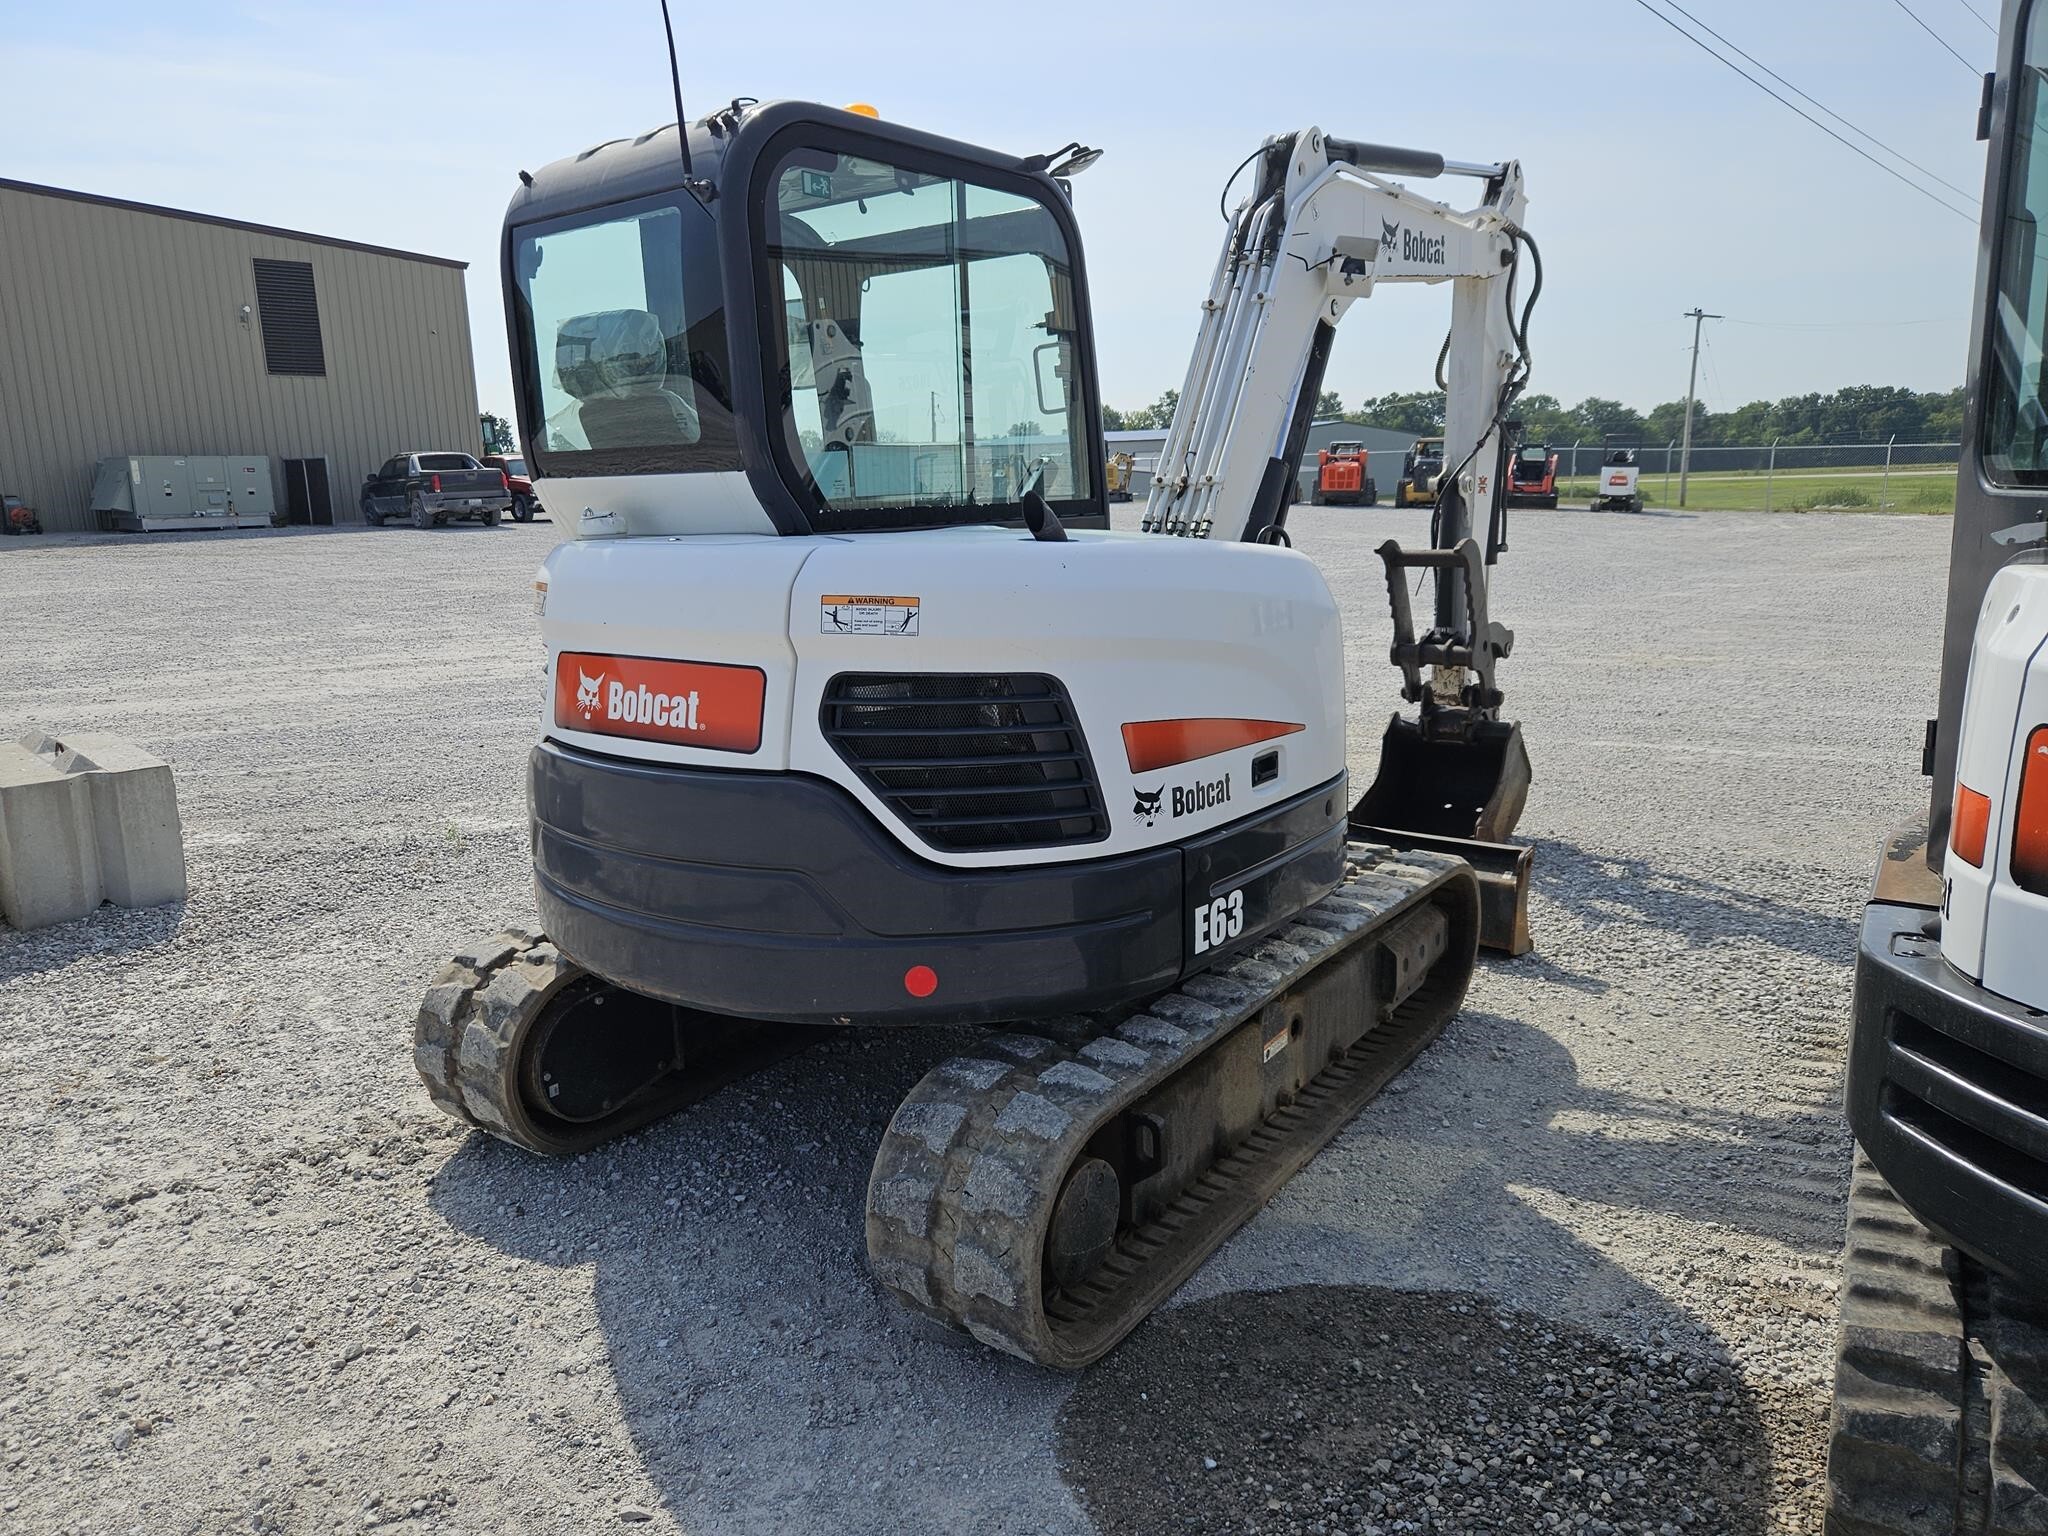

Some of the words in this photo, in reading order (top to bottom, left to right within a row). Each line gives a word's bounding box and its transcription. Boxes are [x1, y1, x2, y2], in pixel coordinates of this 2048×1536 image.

[1403, 228, 1445, 265] Bobcat
[855, 597, 895, 605] WARNING
[1172, 773, 1231, 818] Bobcat
[1194, 889, 1244, 955] E63
